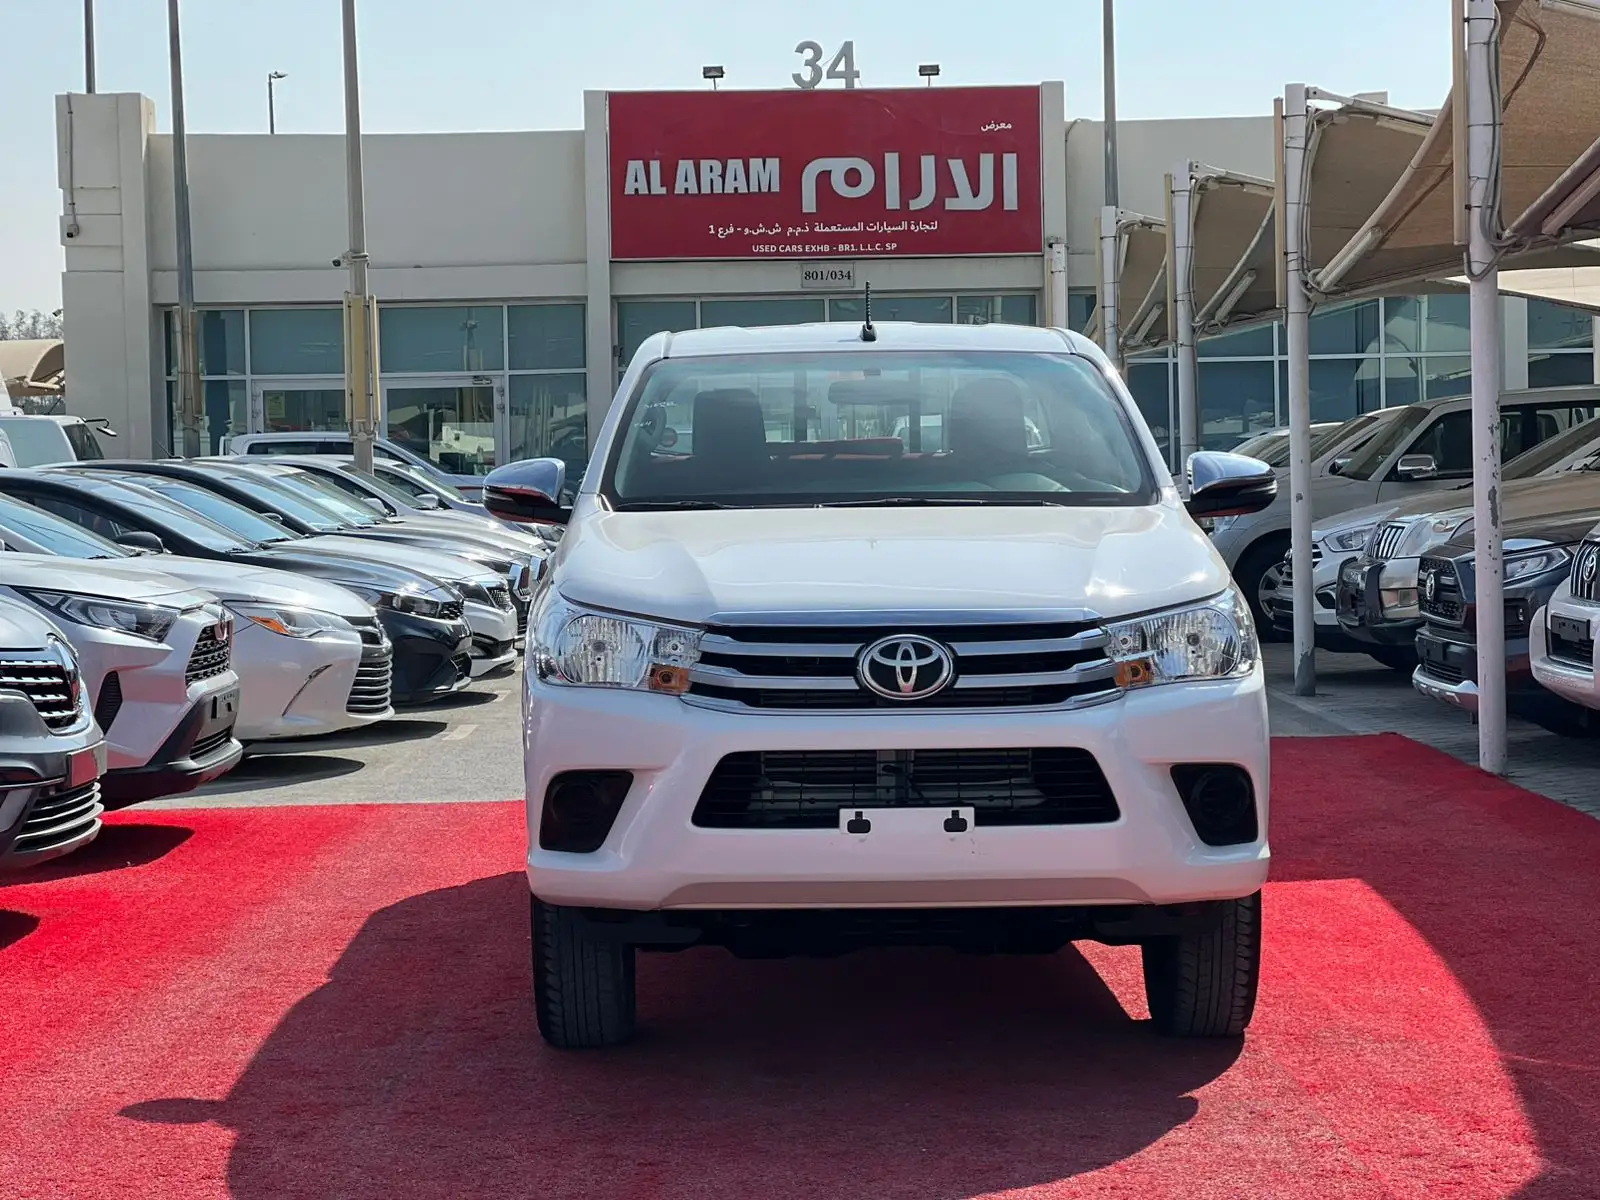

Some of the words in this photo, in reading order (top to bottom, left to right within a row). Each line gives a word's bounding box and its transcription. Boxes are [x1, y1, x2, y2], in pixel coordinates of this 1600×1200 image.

[791, 40, 861, 89] 34
[980, 120, 1012, 132] معرض
[624, 159, 667, 195] AL
[674, 157, 780, 195] ARAM
[801, 151, 1019, 213] الارام
[708, 224, 716, 234] 1
[717, 223, 735, 238] فرع
[813, 221, 864, 232] المستعملة
[866, 220, 908, 234] السيارات
[910, 220, 938, 233] لتجارة
[751, 244, 777, 253] USED
[778, 244, 803, 253] CARS
[804, 244, 830, 252] EXHB
[885, 242, 898, 251] SP
[804, 270, 851, 281] 801/034
